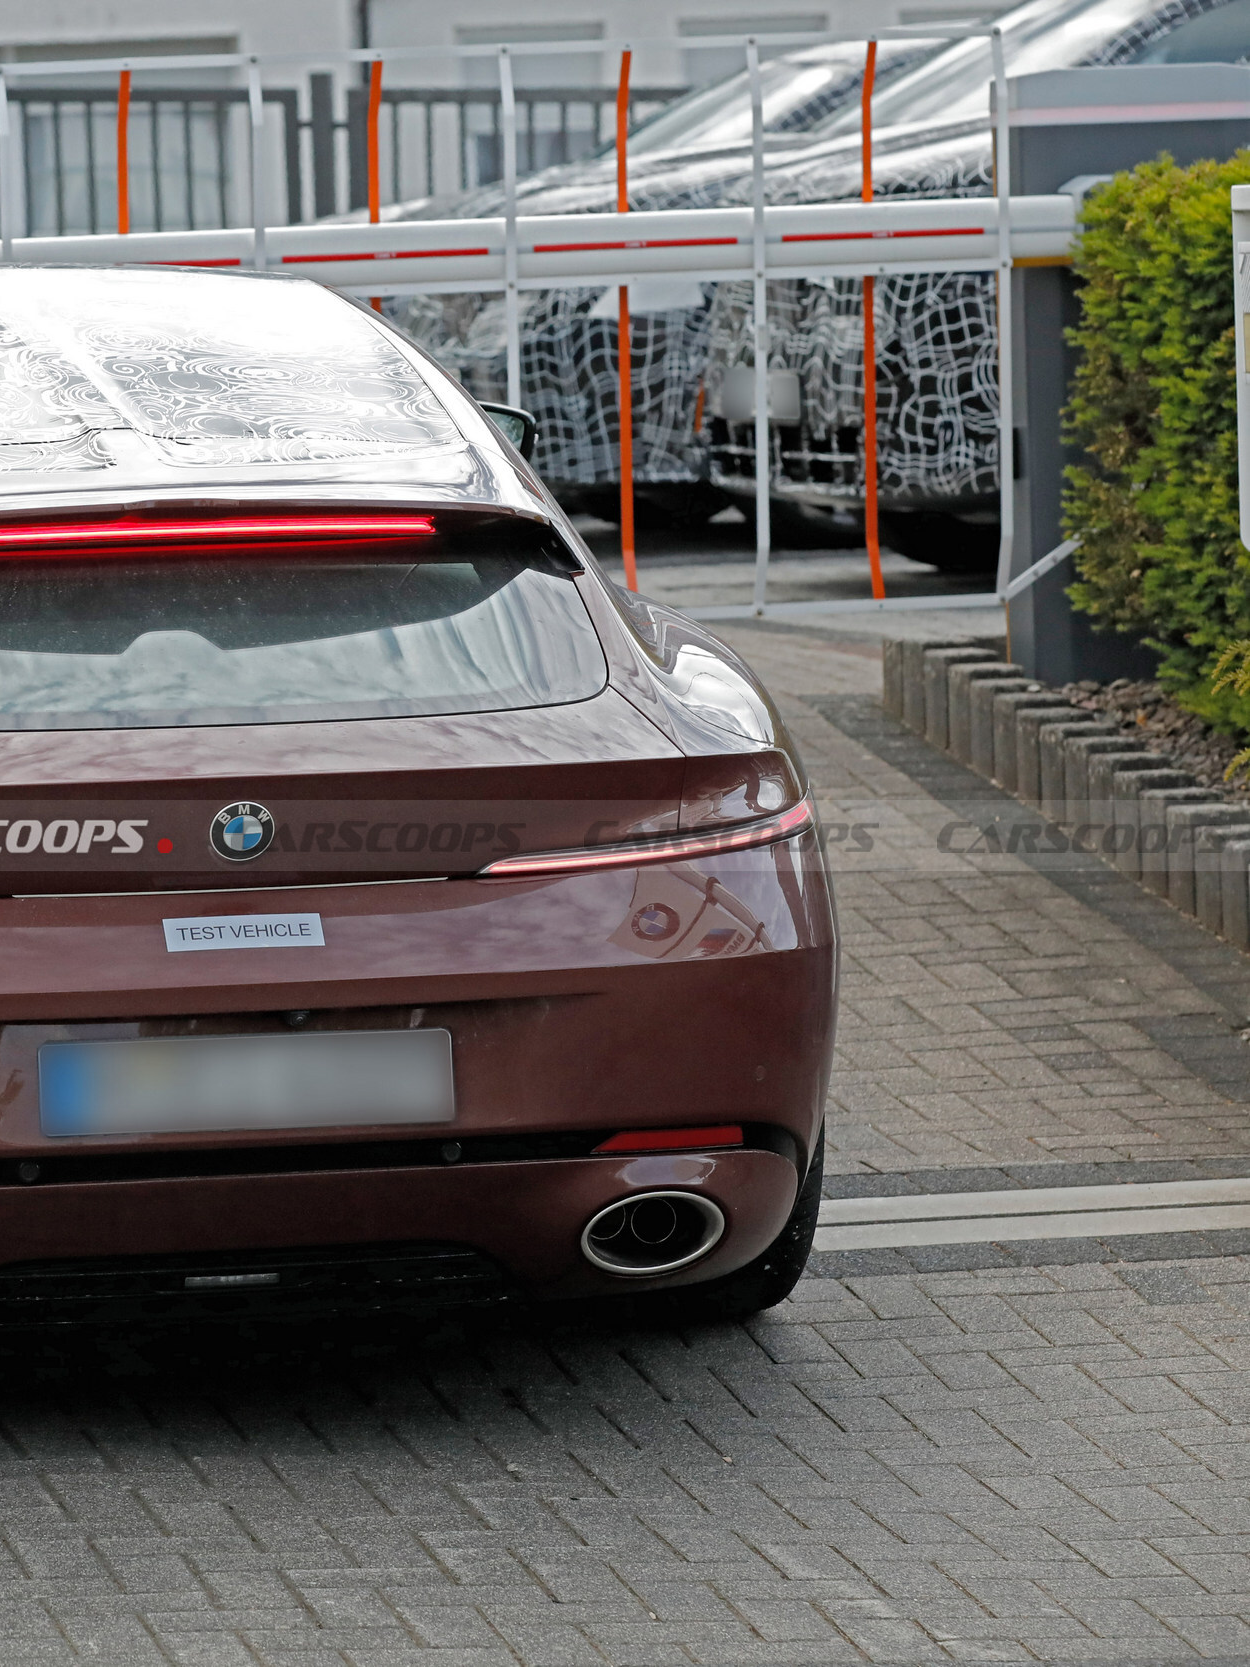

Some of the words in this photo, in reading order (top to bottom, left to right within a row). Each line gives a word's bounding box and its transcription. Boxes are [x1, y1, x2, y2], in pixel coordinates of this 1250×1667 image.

[218, 804, 271, 825] BMW
[176, 926, 226, 941] TEST
[229, 923, 312, 938] VEHICLE
